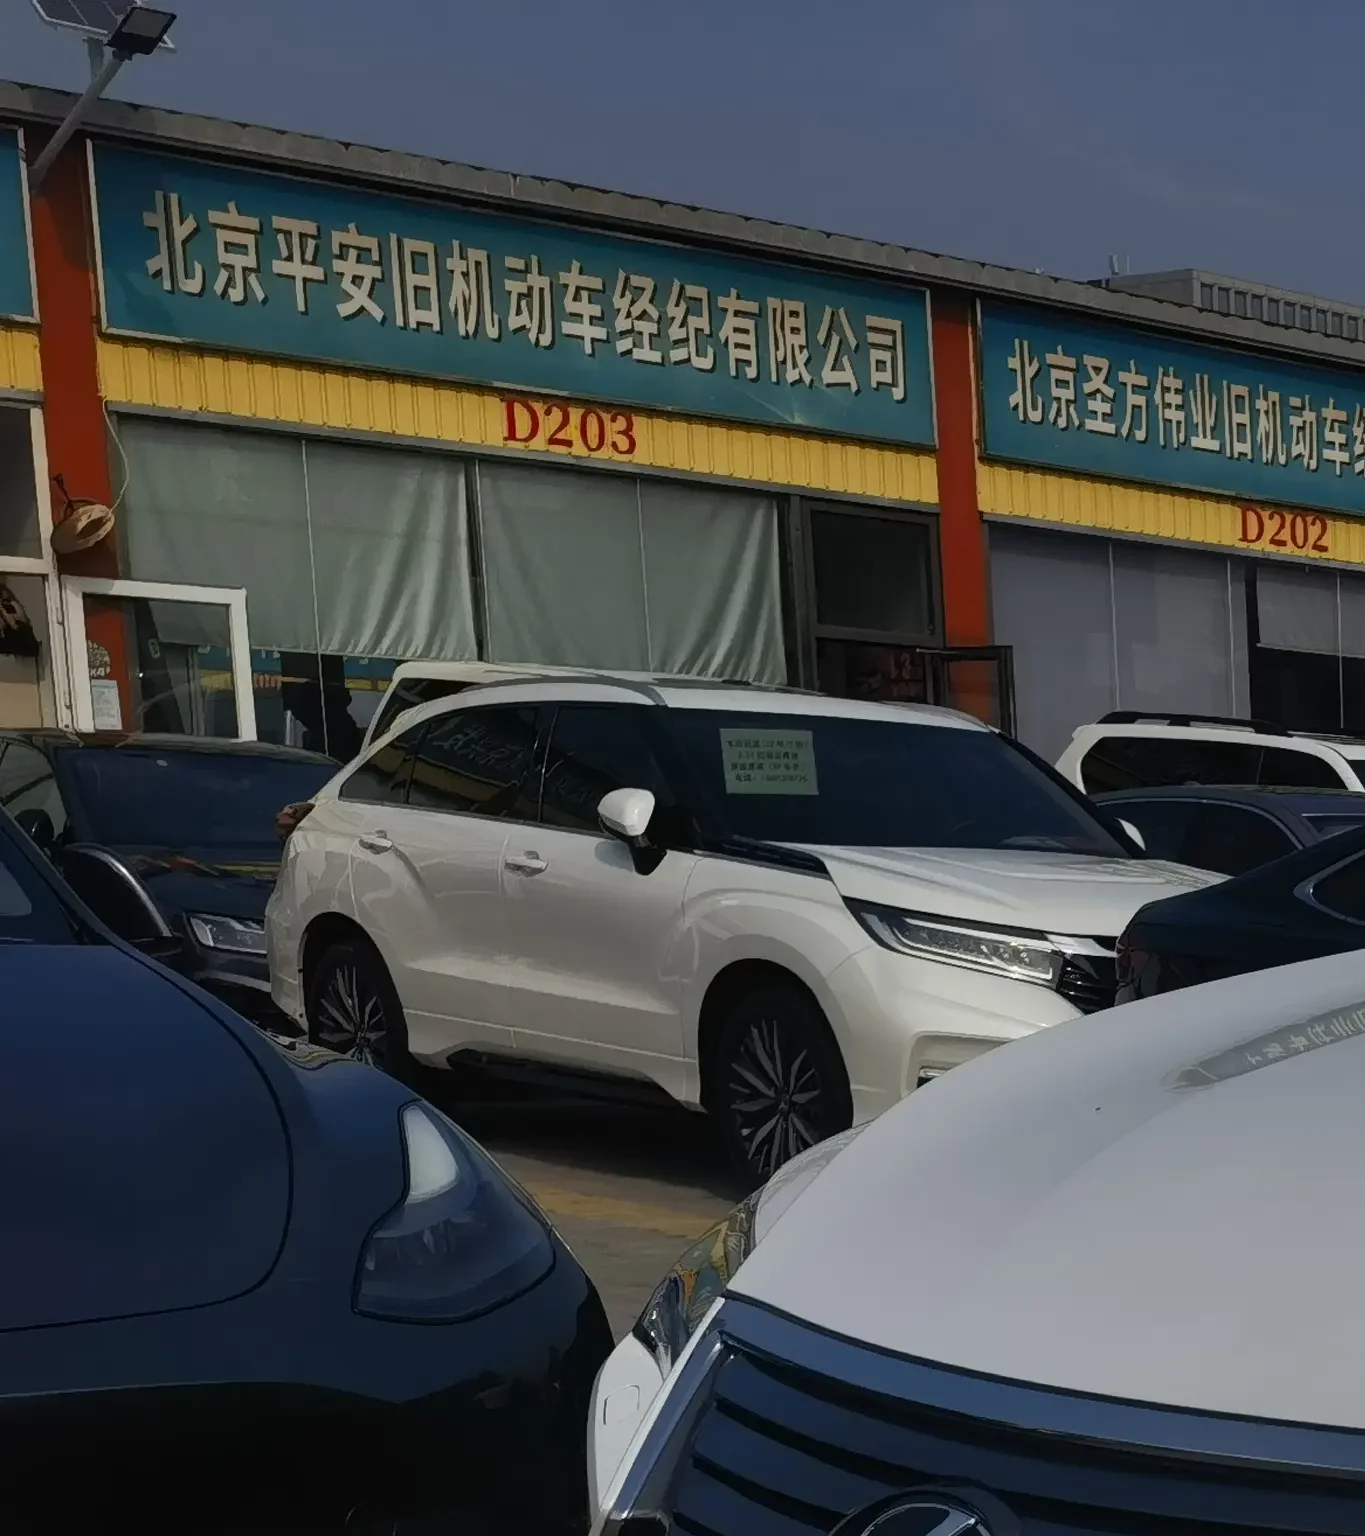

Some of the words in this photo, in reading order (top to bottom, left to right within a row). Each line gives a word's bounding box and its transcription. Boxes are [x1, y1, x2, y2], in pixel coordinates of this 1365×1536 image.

[142, 188, 908, 403] 北京平安旧机动车经纪有限公司
[500, 399, 638, 456] D203
[1237, 506, 1330, 553] D202
